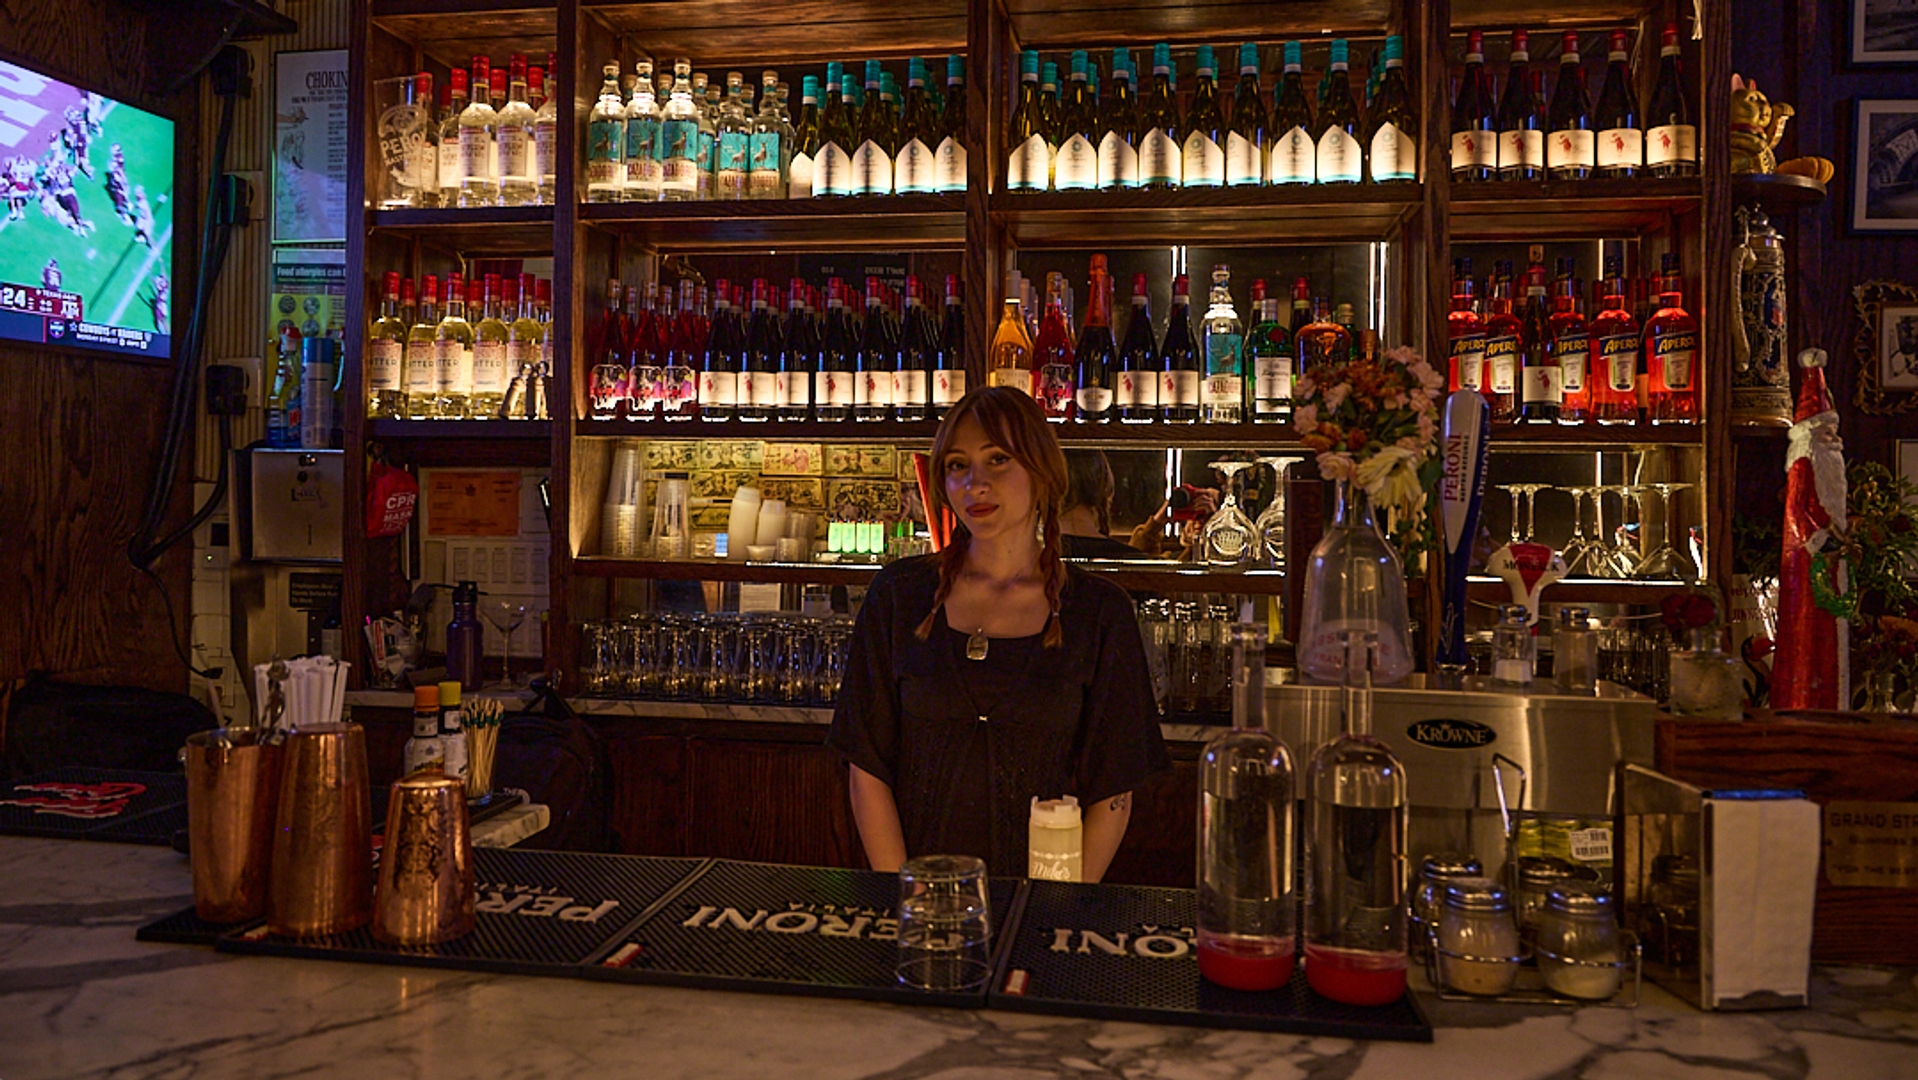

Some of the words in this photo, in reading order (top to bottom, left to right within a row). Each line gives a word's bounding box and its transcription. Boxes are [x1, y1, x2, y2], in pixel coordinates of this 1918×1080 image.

[306, 71, 348, 89] CHOKIN
[380, 131, 424, 159] PERO
[3, 288, 25, 307] 24
[1444, 435, 1461, 502] PERONI
[386, 494, 416, 509] CPR
[1416, 724, 1488, 744] KROWNE
[1830, 813, 1886, 828] GRAND
[1892, 814, 1918, 828] STR
[476, 893, 620, 923] PER
[1050, 928, 1192, 958] ONI
